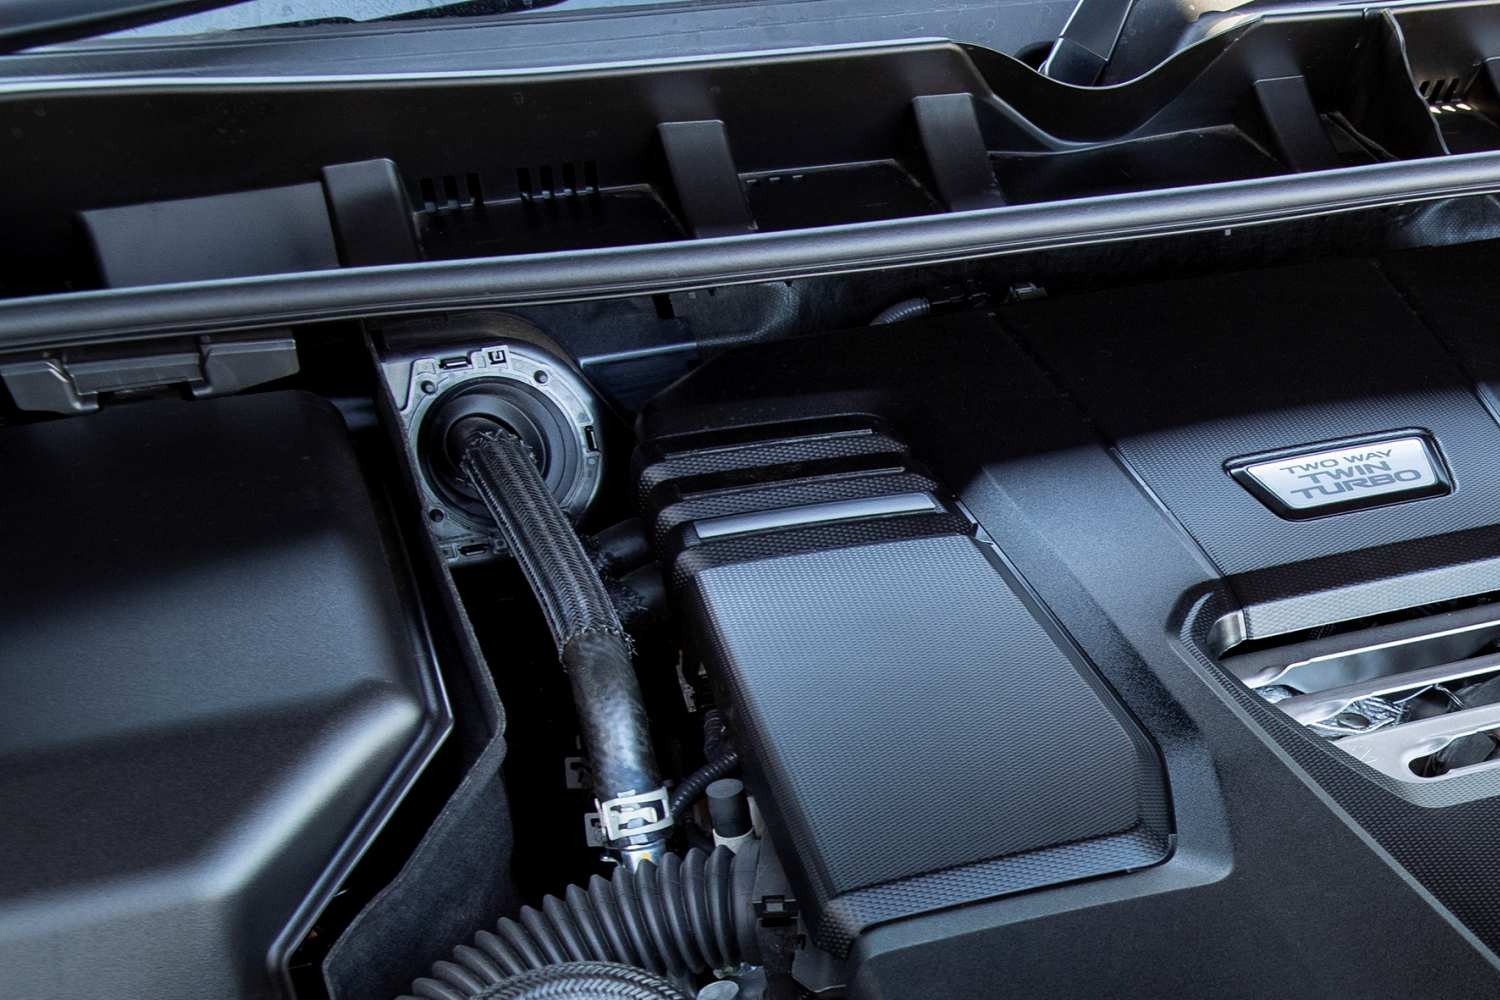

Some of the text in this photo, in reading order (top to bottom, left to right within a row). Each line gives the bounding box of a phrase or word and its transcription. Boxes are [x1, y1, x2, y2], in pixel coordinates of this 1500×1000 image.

[1279, 448, 1393, 475] TWO WAY
[1297, 460, 1392, 484] TWIN
[1289, 468, 1423, 500] TURBO
